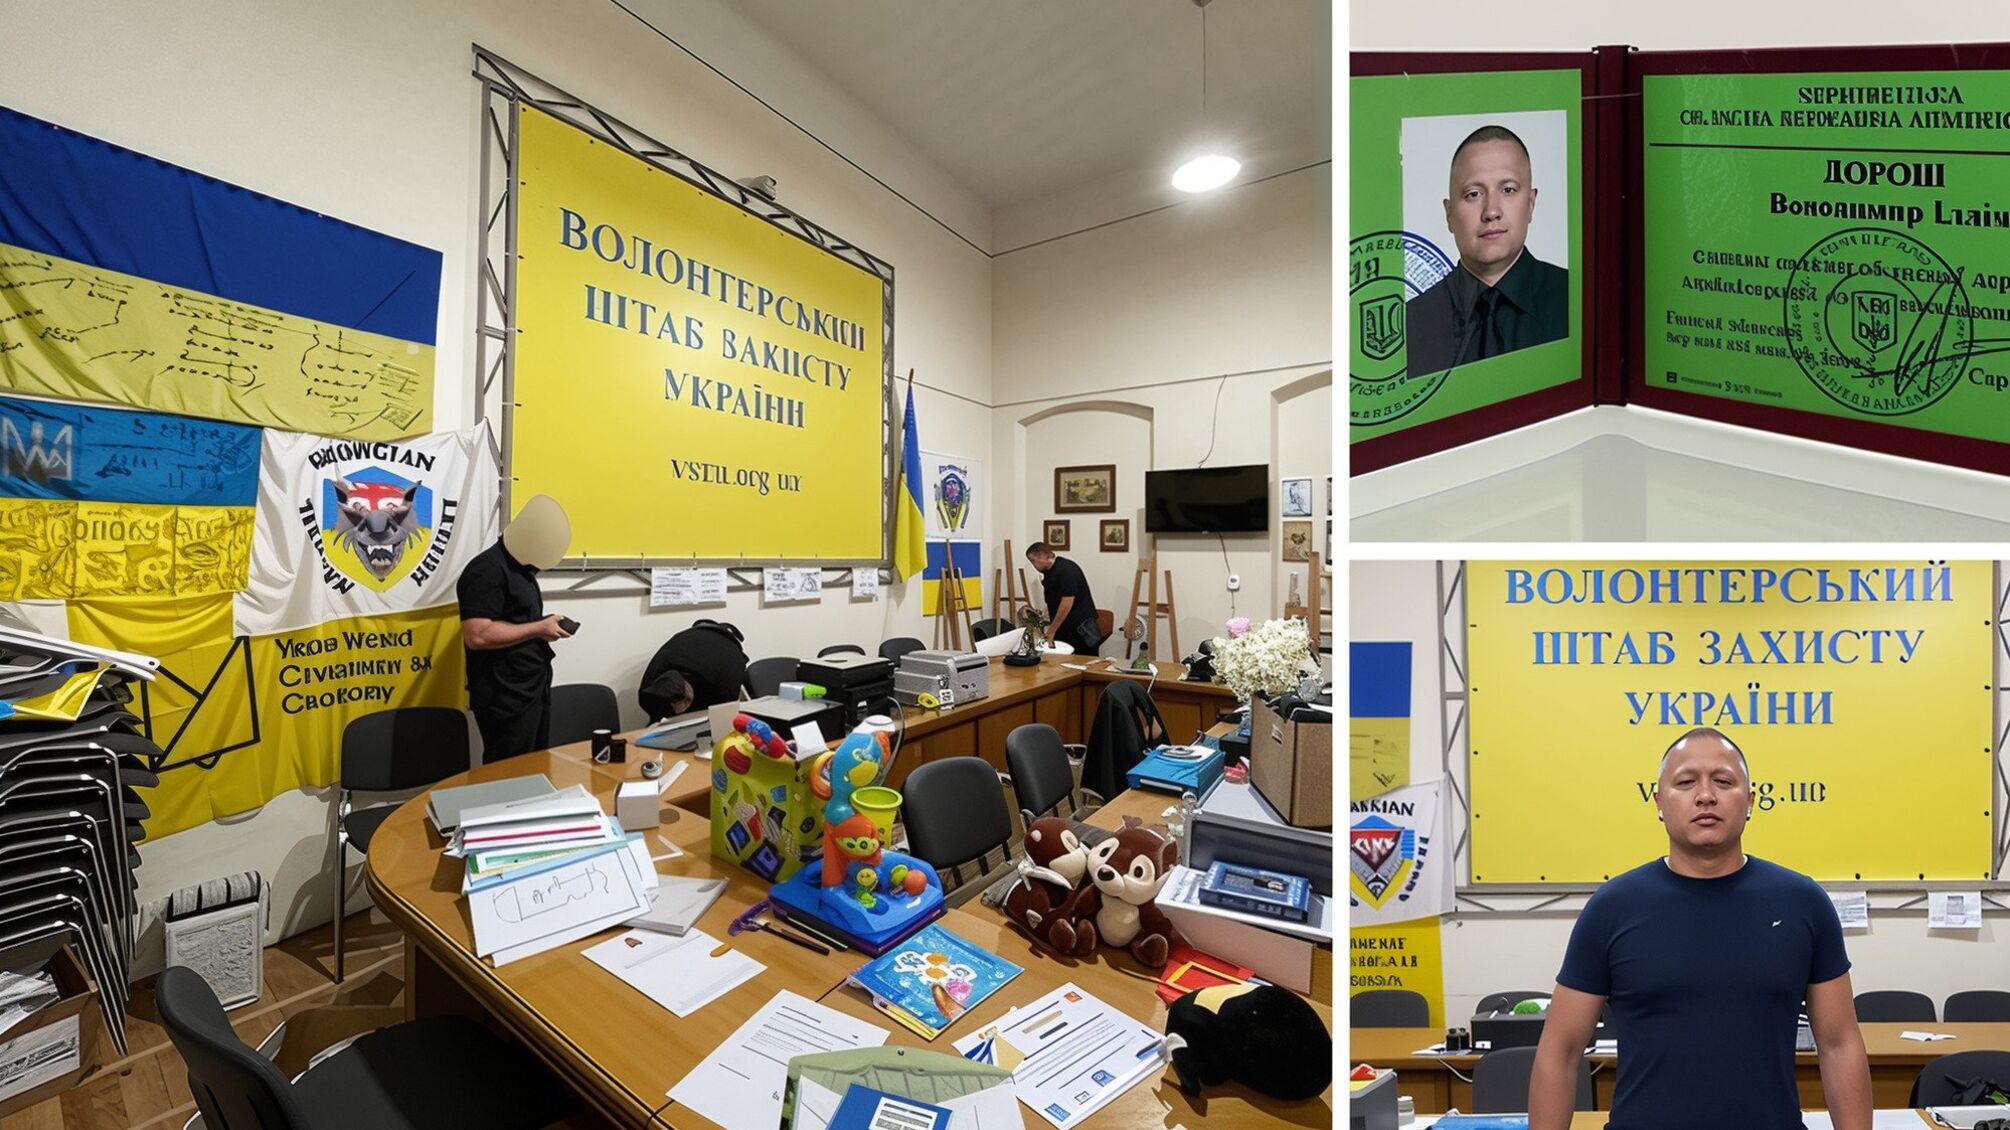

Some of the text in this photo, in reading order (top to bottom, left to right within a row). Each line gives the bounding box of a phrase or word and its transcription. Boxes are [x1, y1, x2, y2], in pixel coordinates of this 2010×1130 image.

[1823, 160, 1946, 188] ДОРОШ
[1505, 559, 1954, 605] ВОЛОНТЕРСЬКИЙ
[1532, 629, 1925, 665] ШТАБ ЗАХИСТУ
[1624, 682, 1834, 725] УКРАЇНИ
